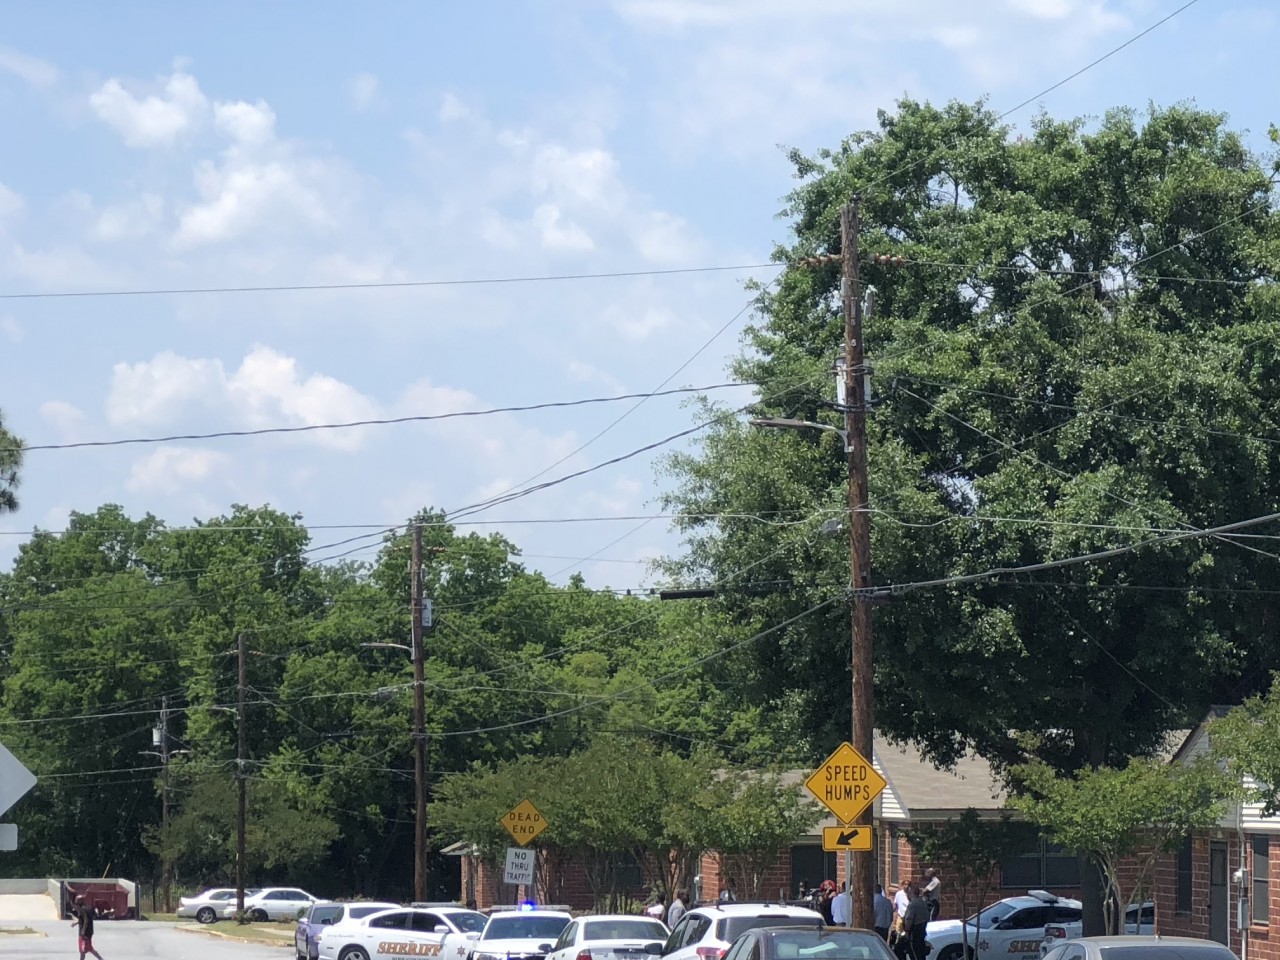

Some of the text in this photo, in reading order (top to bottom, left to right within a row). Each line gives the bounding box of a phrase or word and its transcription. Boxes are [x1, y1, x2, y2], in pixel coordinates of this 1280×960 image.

[825, 765, 867, 781] SPEED
[825, 785, 870, 801] HUMPS
[509, 812, 540, 823] DEAD
[512, 825, 535, 834] END
[514, 851, 527, 860] NO
[511, 861, 529, 871] THRU
[377, 941, 443, 957] SHERIFF
